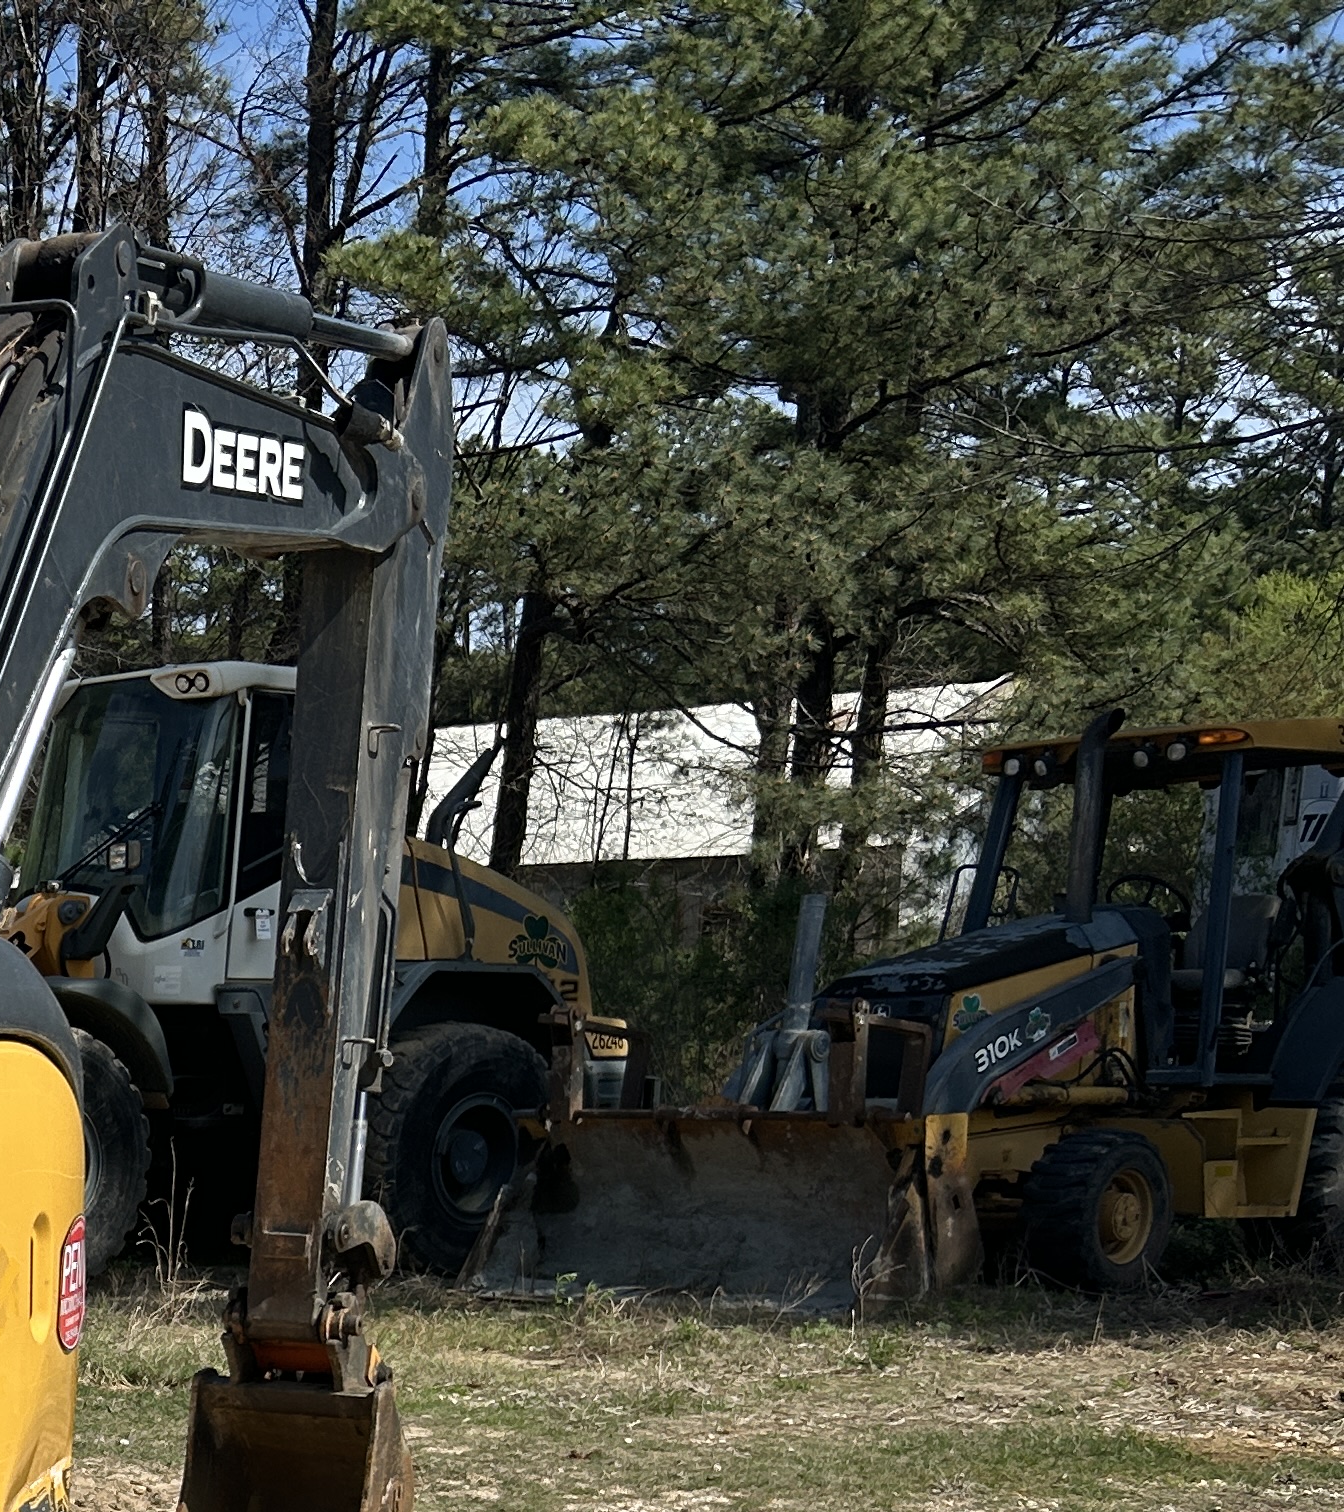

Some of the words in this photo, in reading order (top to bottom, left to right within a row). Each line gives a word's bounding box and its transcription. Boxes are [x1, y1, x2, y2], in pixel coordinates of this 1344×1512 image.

[182, 410, 305, 500] DEERE
[508, 939, 568, 965] SULLIVAN
[974, 1027, 1023, 1073] 310K
